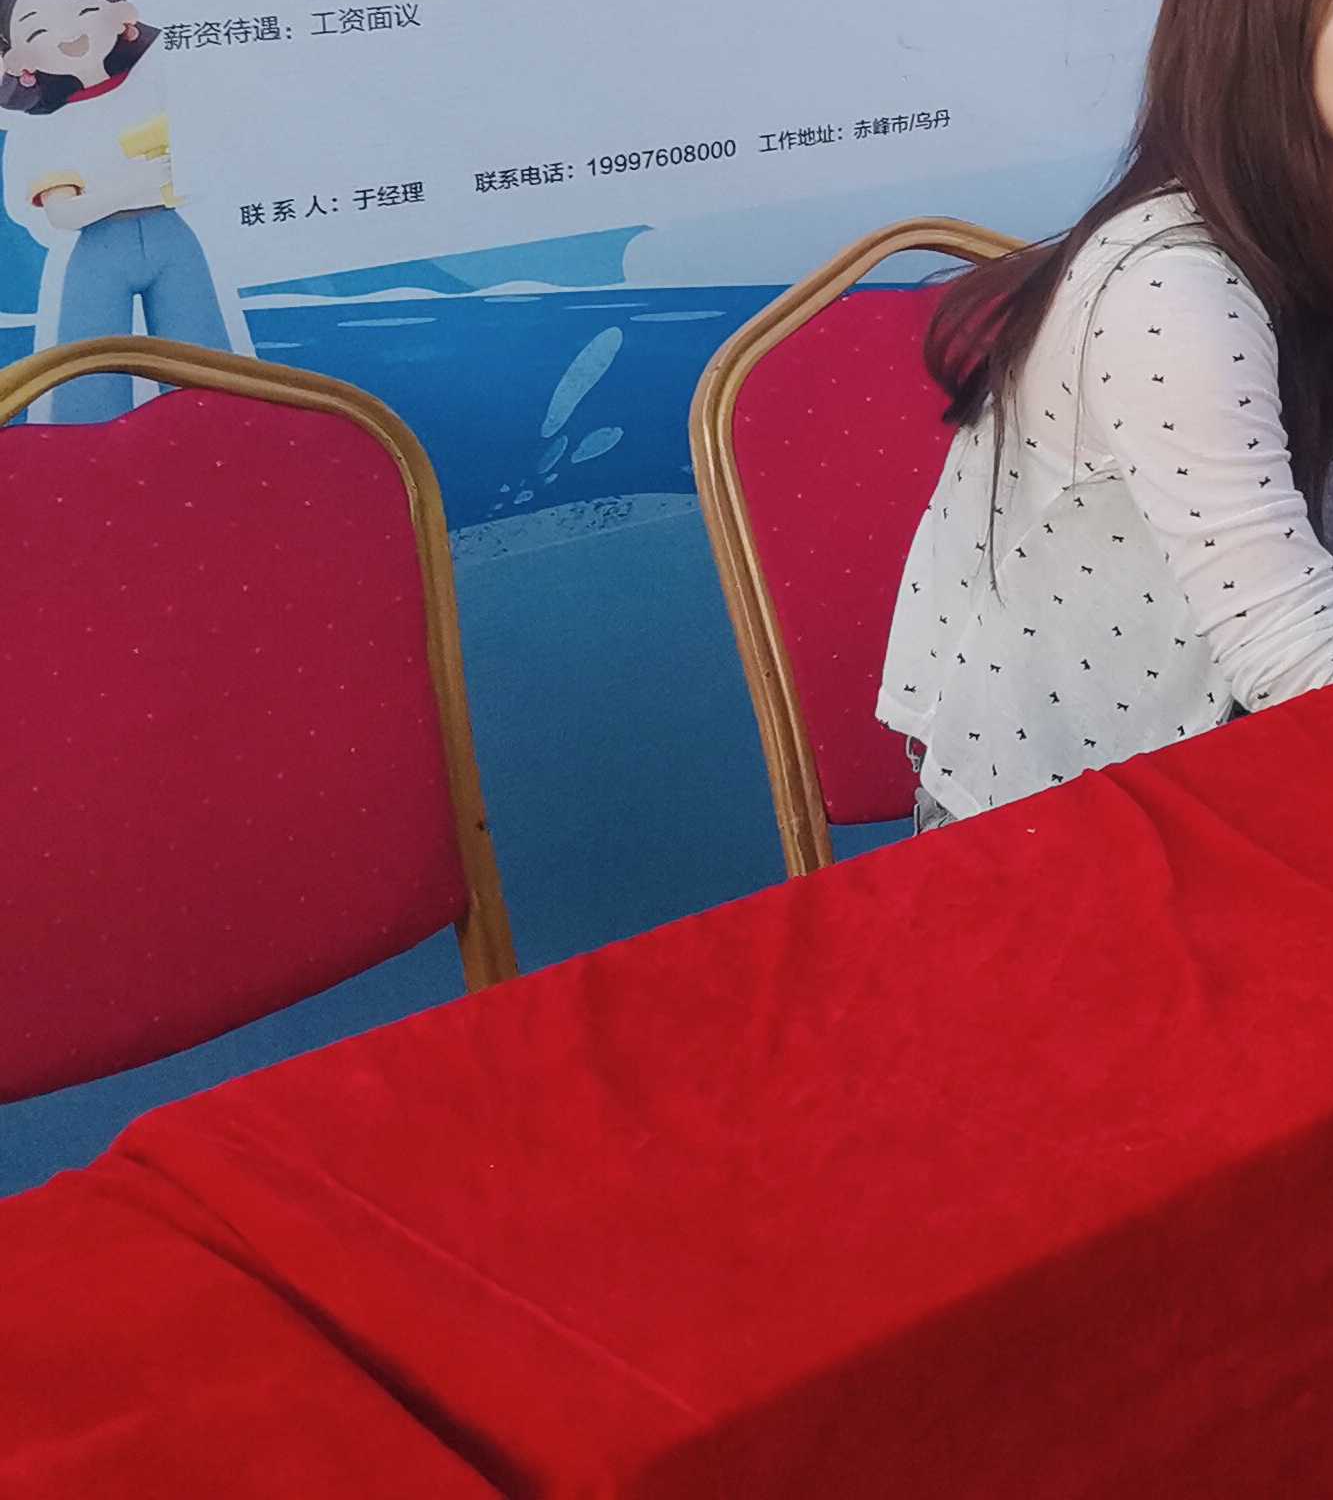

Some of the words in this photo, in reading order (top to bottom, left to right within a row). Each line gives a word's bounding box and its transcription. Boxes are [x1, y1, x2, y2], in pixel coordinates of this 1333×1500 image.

[163, 2, 422, 52] 薪资待遇：工资面议
[473, 137, 737, 194] 联系电话：19997608000
